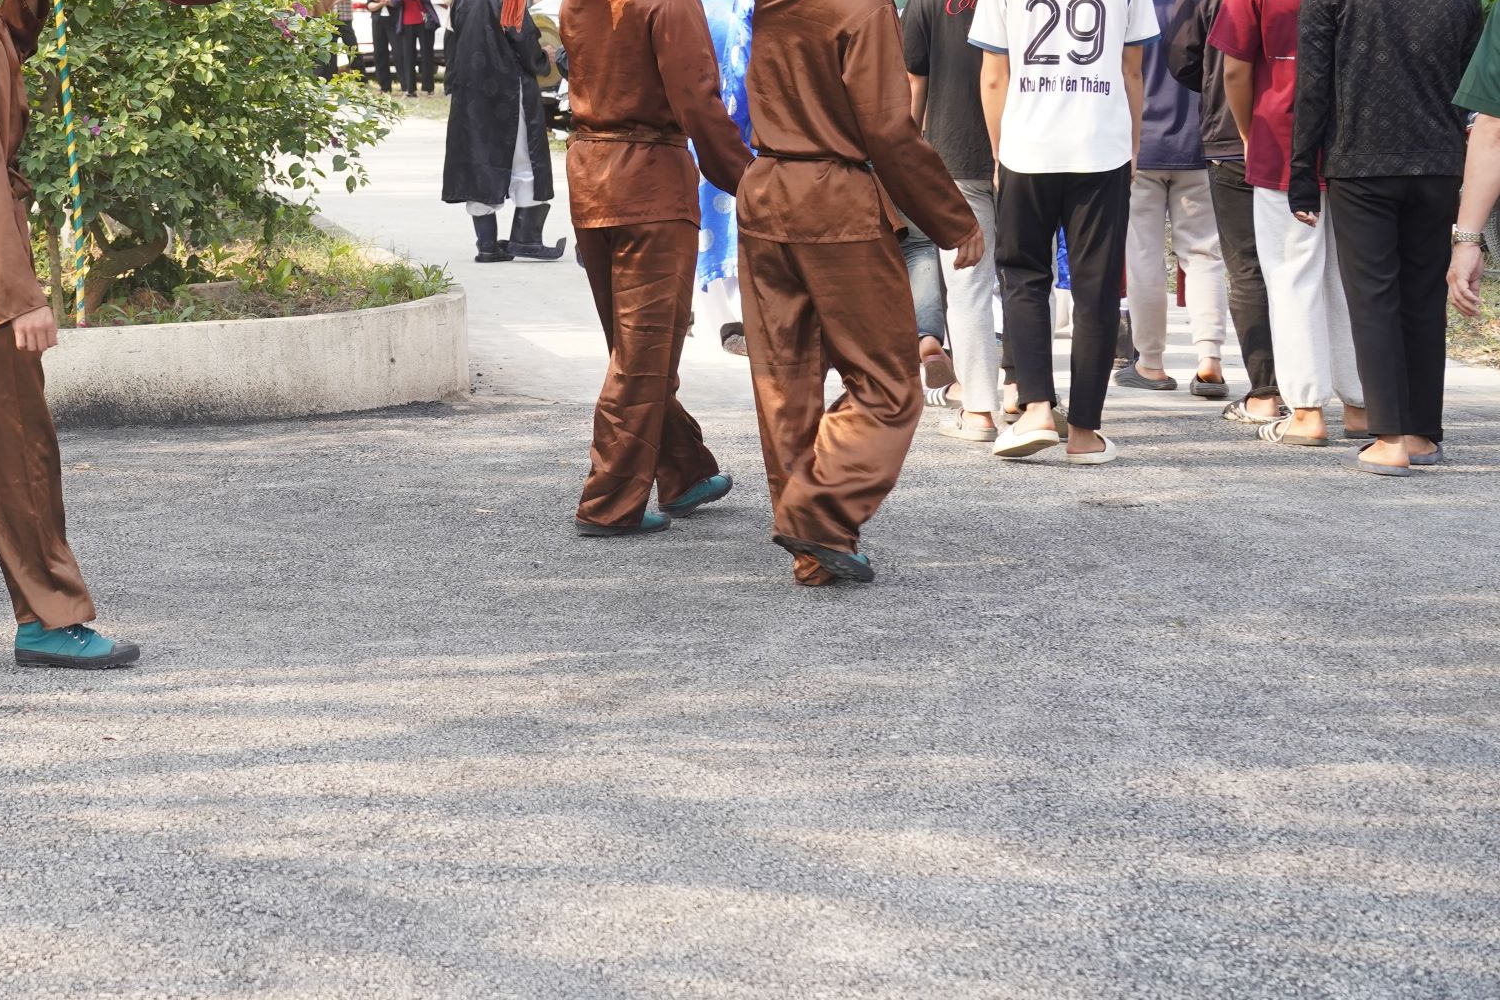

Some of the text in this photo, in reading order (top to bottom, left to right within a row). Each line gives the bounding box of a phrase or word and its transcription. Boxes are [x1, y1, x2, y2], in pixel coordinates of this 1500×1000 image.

[1019, 77, 1036, 93] Khu
[1060, 75, 1077, 93] Yên
[1080, 73, 1111, 96] Thắng
